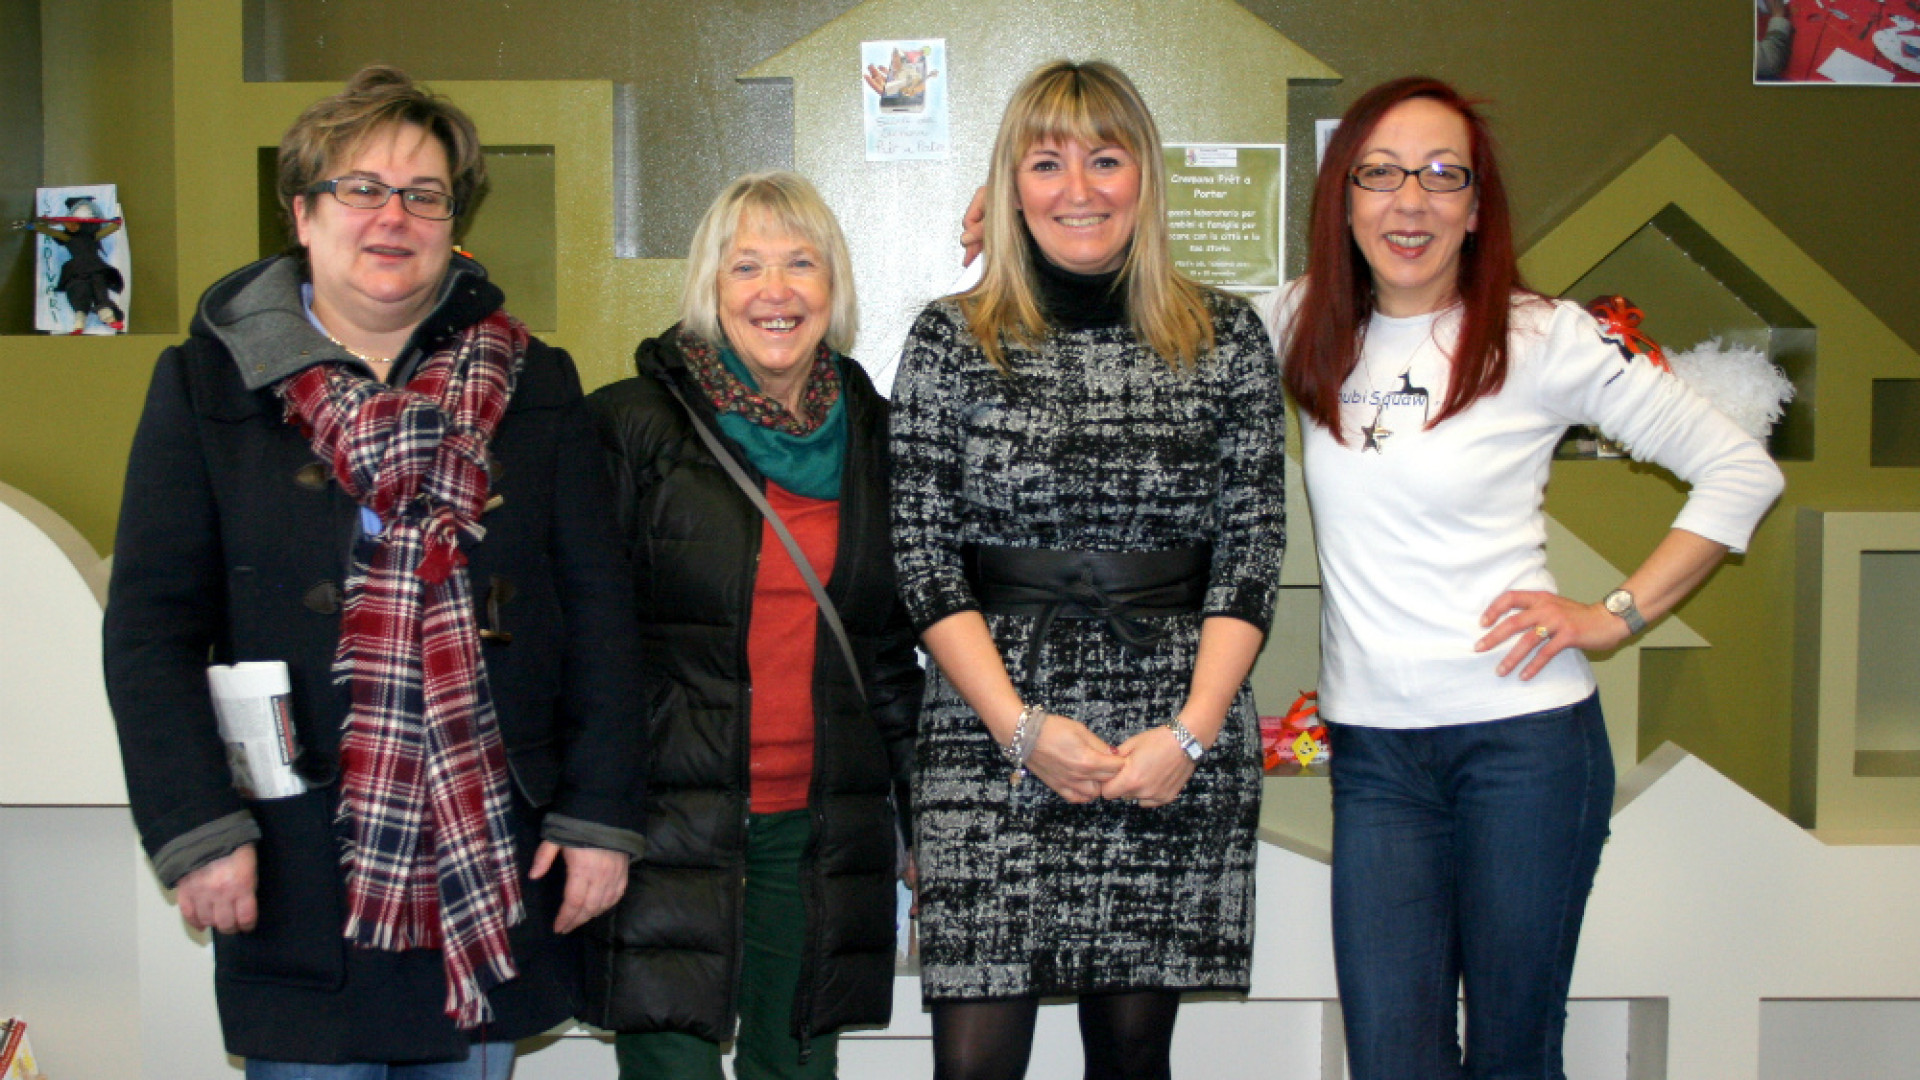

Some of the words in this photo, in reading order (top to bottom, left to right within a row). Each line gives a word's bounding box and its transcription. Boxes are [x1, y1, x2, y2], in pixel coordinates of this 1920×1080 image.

[1171, 174, 1214, 185] Cremona
[1194, 188, 1227, 198] Porter
[1242, 210, 1256, 219] per
[1242, 222, 1256, 231] per
[1369, 391, 1425, 410] Squaw
